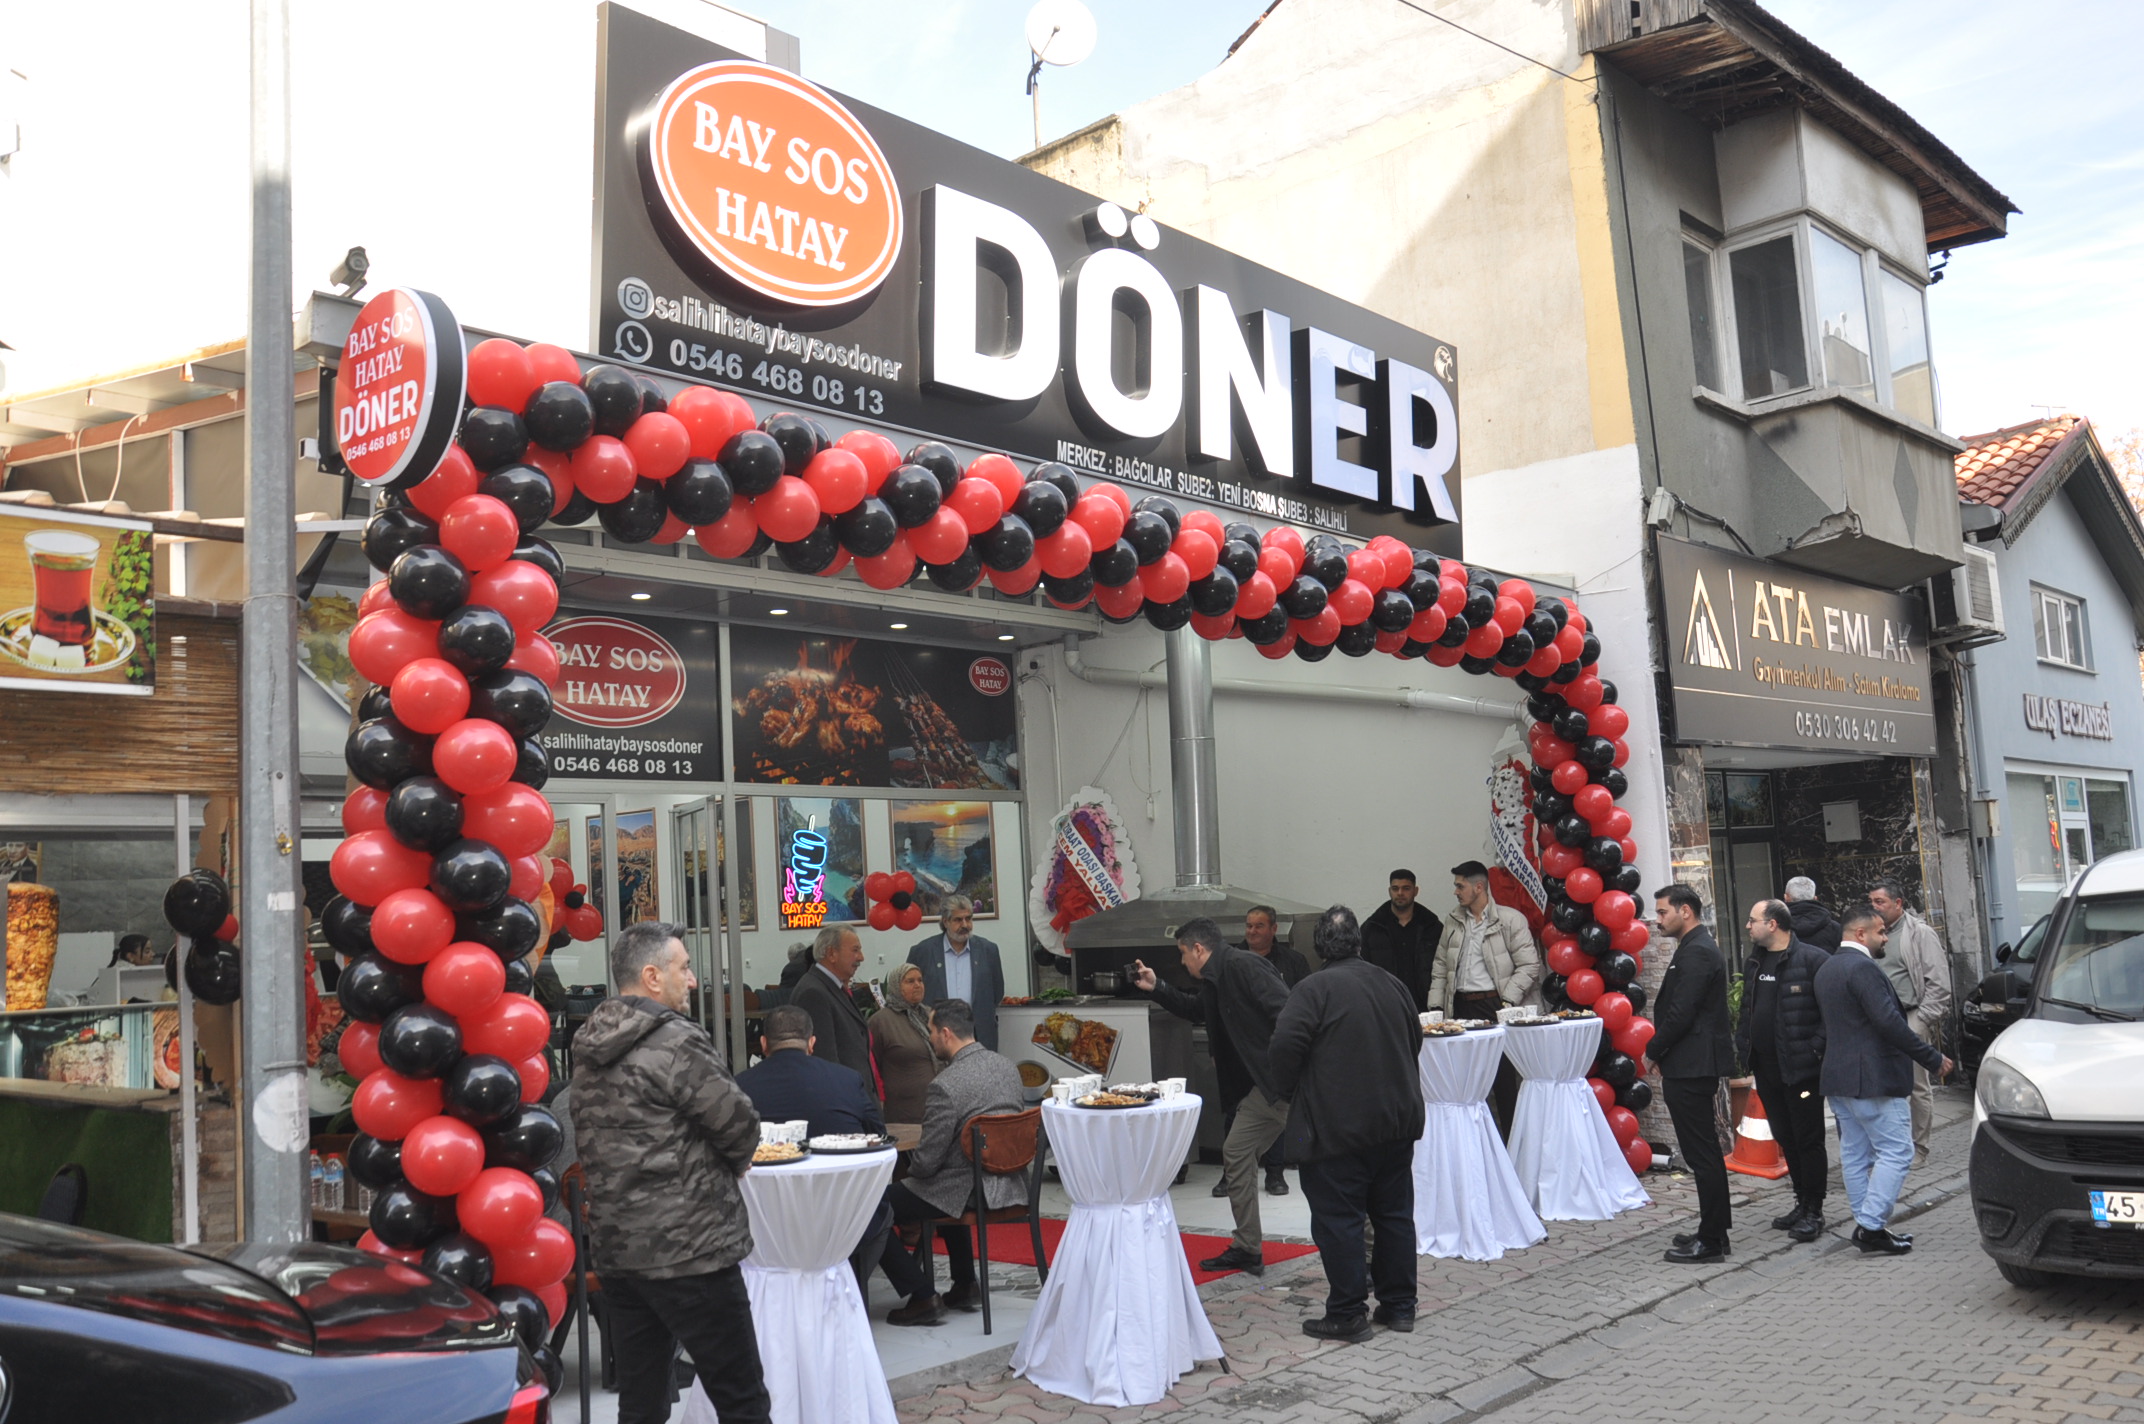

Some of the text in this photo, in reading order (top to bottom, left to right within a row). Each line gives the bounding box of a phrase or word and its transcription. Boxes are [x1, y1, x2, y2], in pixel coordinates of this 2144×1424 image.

[693, 101, 869, 205] BAY SOS
[715, 187, 848, 272] HATAY
[349, 307, 413, 359] BAY SOS
[654, 296, 902, 381] salihlihataybaysosdoner
[355, 344, 404, 389] HATAY
[933, 183, 1459, 523] DÖNER
[669, 339, 884, 415] 0546 468 08 13
[340, 379, 418, 444] DÖNER
[346, 426, 411, 461] 0546 468 08 13
[1057, 440, 1106, 472] MERKEZ
[1115, 456, 1172, 489] BAĞCILAR
[1177, 472, 1214, 499] ŞUBE2:
[1218, 482, 1240, 506] YENİ
[1243, 488, 1277, 515] BOSNA
[1278, 497, 1307, 522] ŞUBE3
[1315, 507, 1347, 532] SALİHLİ
[1751, 580, 1915, 664] ATA EMLAK
[553, 641, 664, 673] BAY SOS
[975, 665, 1005, 677] BAY SOS
[566, 680, 651, 708] HATAY
[979, 679, 1002, 689] HATAY
[1752, 656, 1821, 690] Gayrimenkul
[1881, 675, 1921, 701] Kiralama
[1795, 711, 1897, 743] 0530 306 42 42
[2024, 693, 2113, 740] ULAŞ ECZANESİ
[543, 733, 703, 755] salihlihataybaysosdoner
[554, 756, 693, 775] 0546 468 08 13
[1057, 832, 1074, 857] CEM
[1077, 848, 1100, 874] ODASI
[1508, 860, 1544, 910] KARAMAN
[782, 902, 828, 914] BAY SOS
[788, 914, 823, 928] HATAY
[2094, 1208, 2105, 1216] TR
[2107, 1196, 2135, 1218] 45
